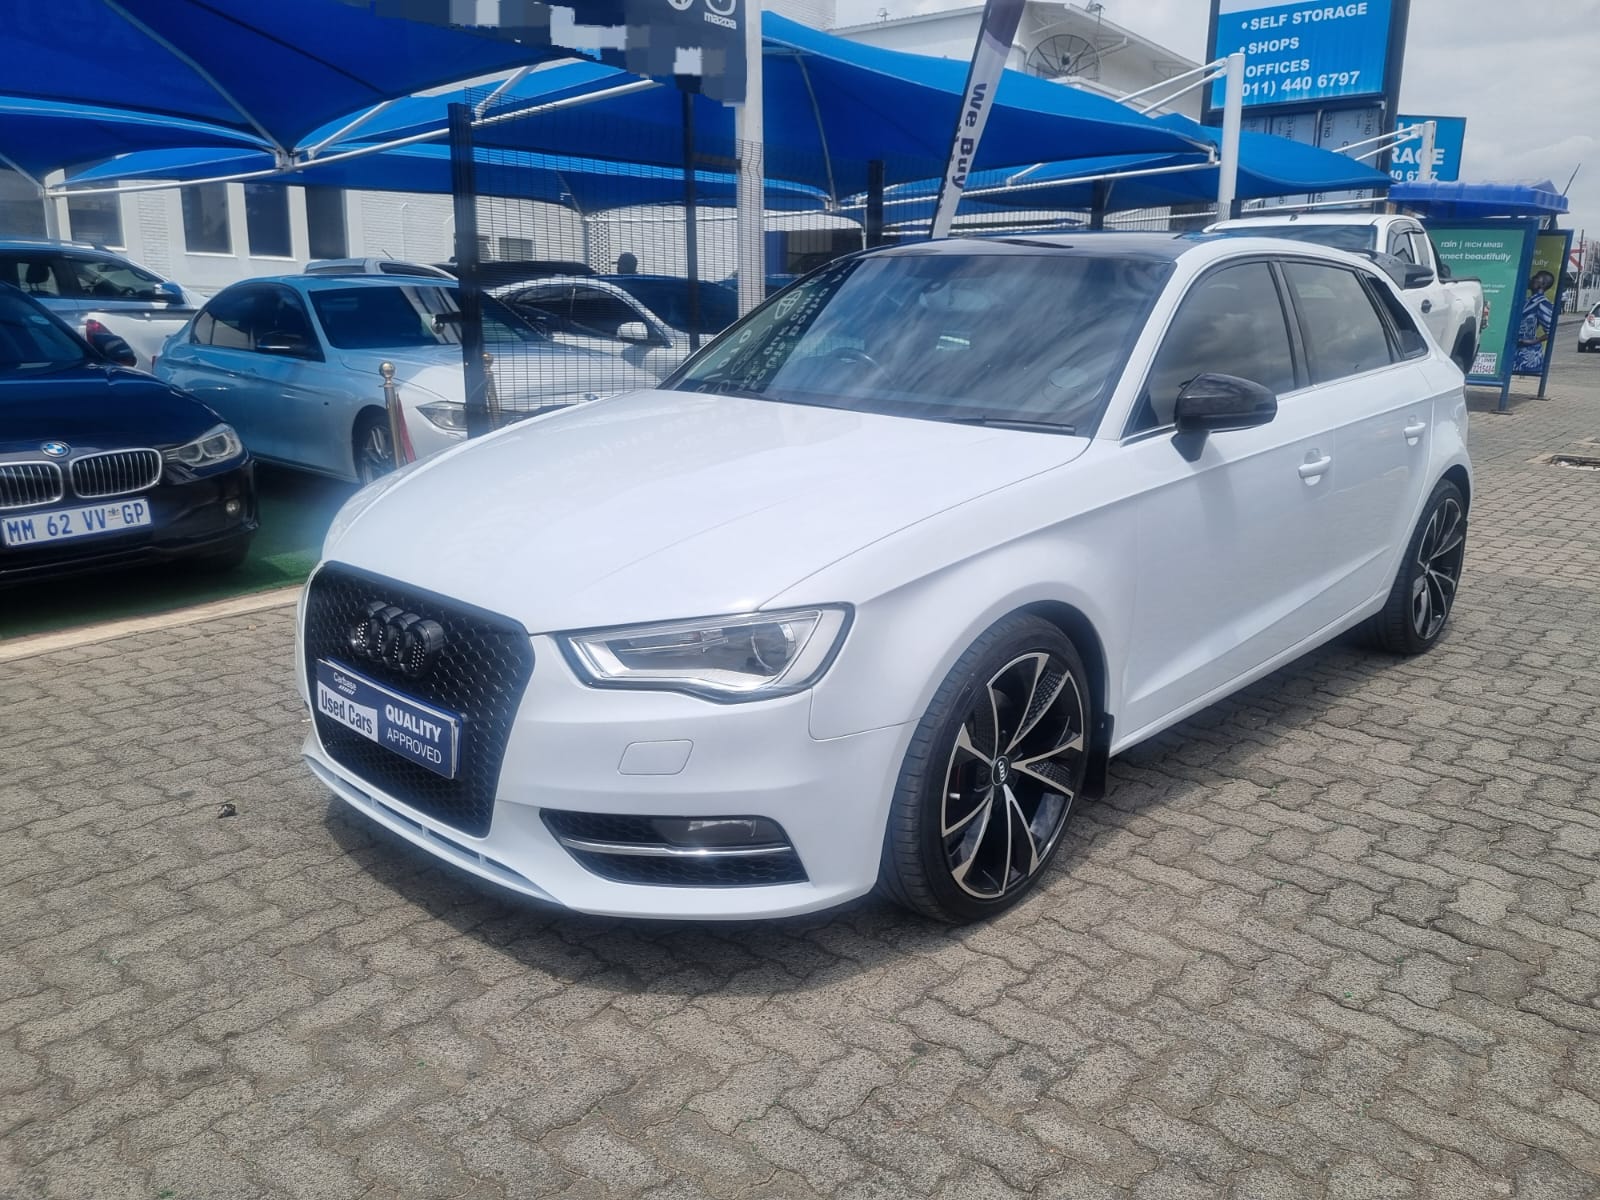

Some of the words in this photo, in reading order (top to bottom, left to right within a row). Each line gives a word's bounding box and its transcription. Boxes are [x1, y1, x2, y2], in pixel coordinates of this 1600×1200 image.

[703, 11, 737, 30] mazda
[1250, 14, 1288, 31] SELF
[1292, 2, 1368, 25] STORAGE
[1247, 36, 1300, 55] SHOPS
[1245, 58, 1310, 78] OFFICES
[1281, 76, 1312, 92] 440
[1317, 70, 1361, 88] 6797
[965, 83, 987, 127] We
[952, 138, 975, 189] Buy
[1440, 240, 1457, 248] rain
[1464, 252, 1512, 263] beautifully
[7, 519, 36, 543] MM
[47, 513, 73, 537] 62
[82, 508, 106, 531] VV
[121, 502, 144, 525] GP
[320, 689, 345, 721] Used
[349, 701, 373, 735] Cars
[385, 703, 442, 743] QUALITY
[386, 727, 442, 764] APPROVED
